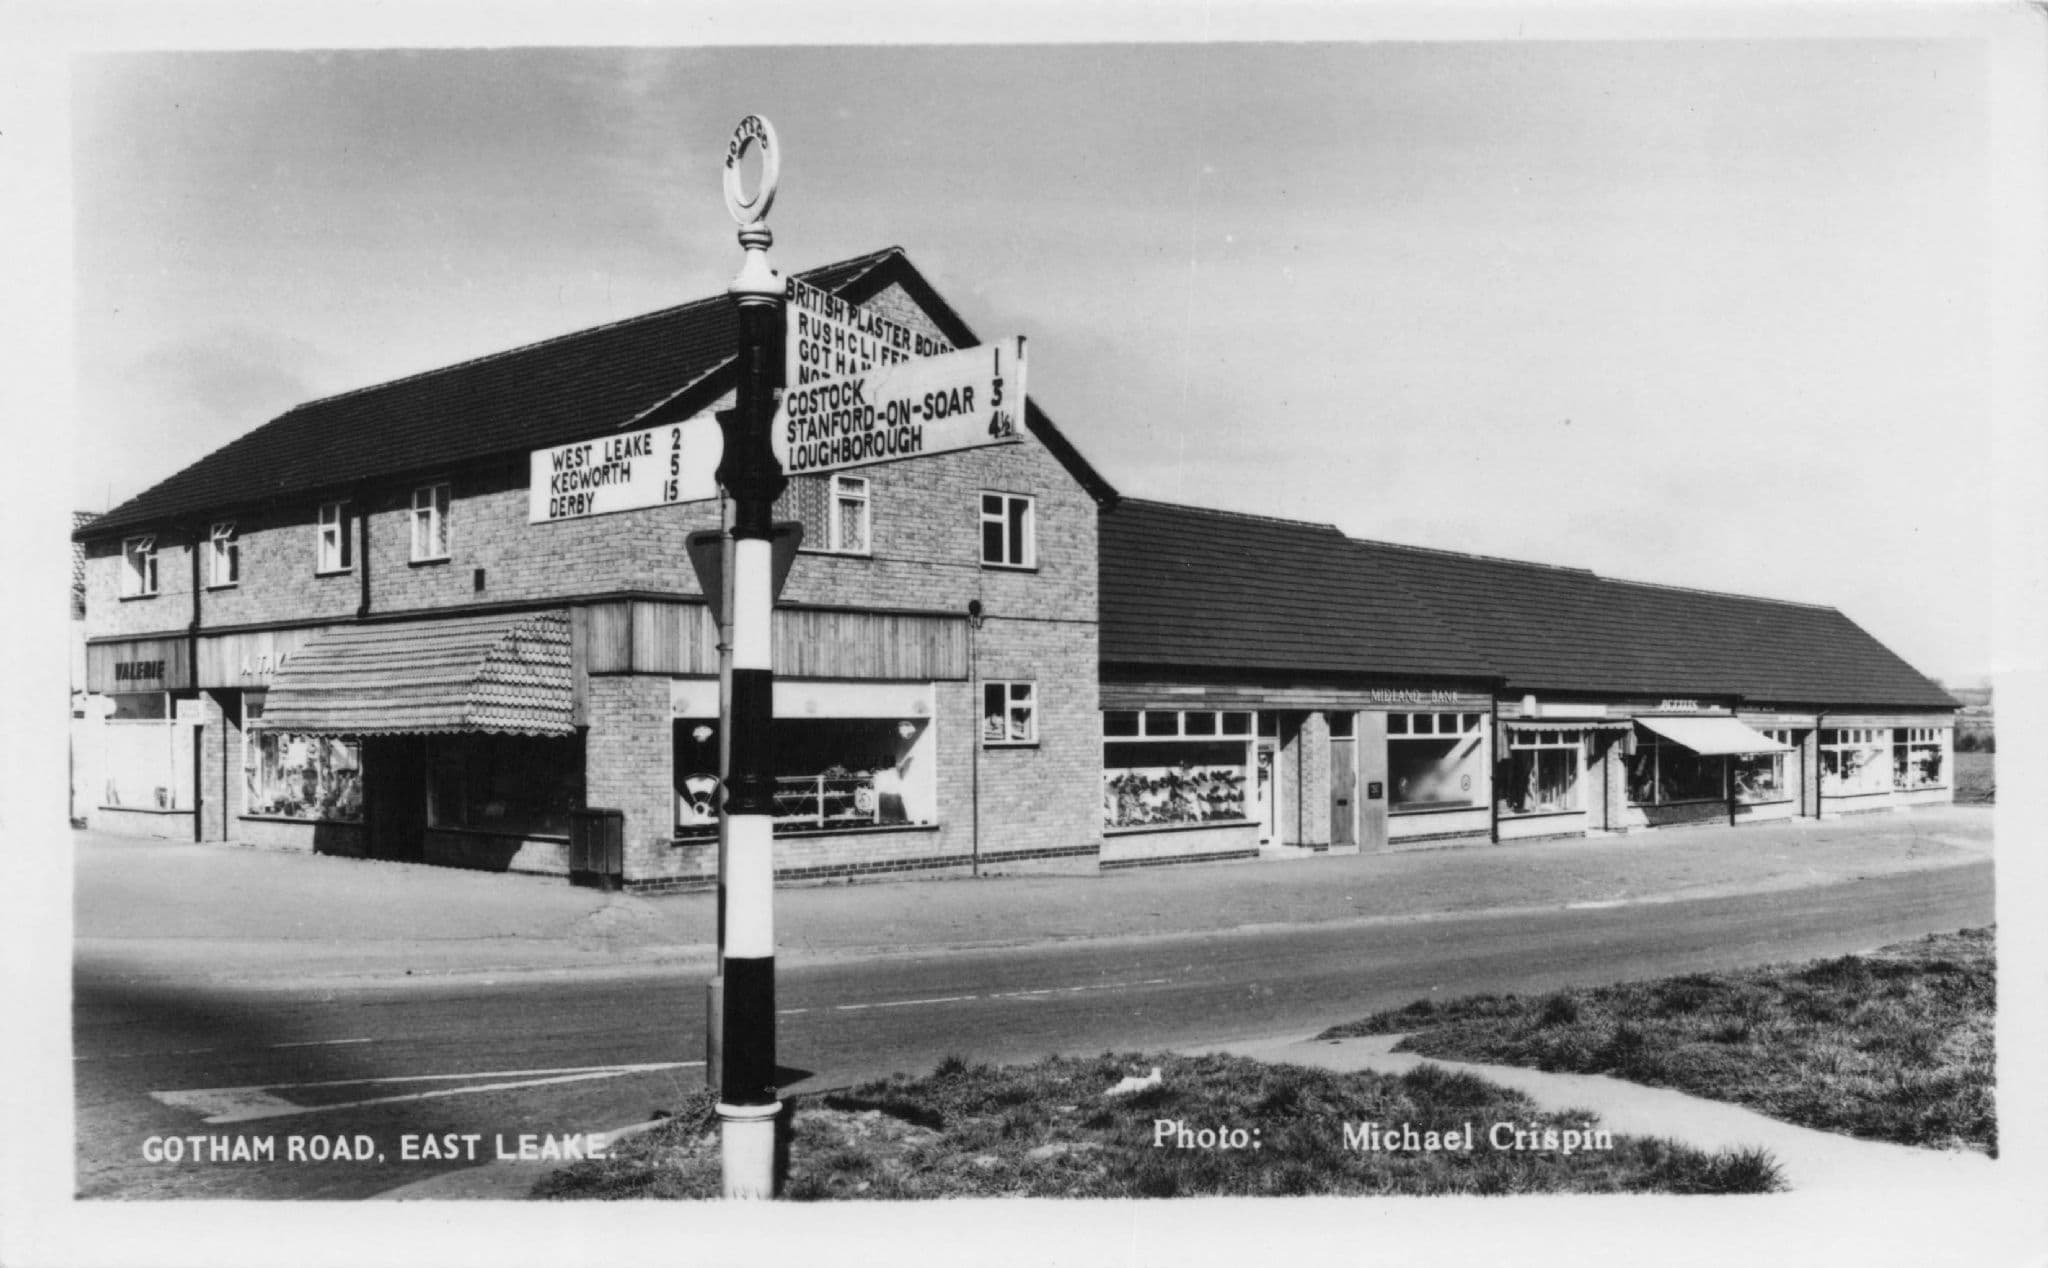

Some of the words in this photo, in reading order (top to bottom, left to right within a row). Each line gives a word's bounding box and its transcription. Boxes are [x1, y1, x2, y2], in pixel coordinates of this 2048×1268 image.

[786, 277, 844, 322] BRITISH
[847, 303, 911, 352] PLASTER
[787, 379, 865, 418] COSTOCK
[787, 385, 975, 444] STANFORD-ON-SOAR
[551, 445, 592, 473] WEST
[605, 433, 653, 463] LEAKE
[671, 427, 681, 451] 2
[789, 424, 922, 471] LOUGHBOROUGH
[551, 461, 631, 496] KEGWORTH
[670, 453, 680, 477] 5
[549, 491, 595, 519] DERBY
[663, 479, 678, 502] 15
